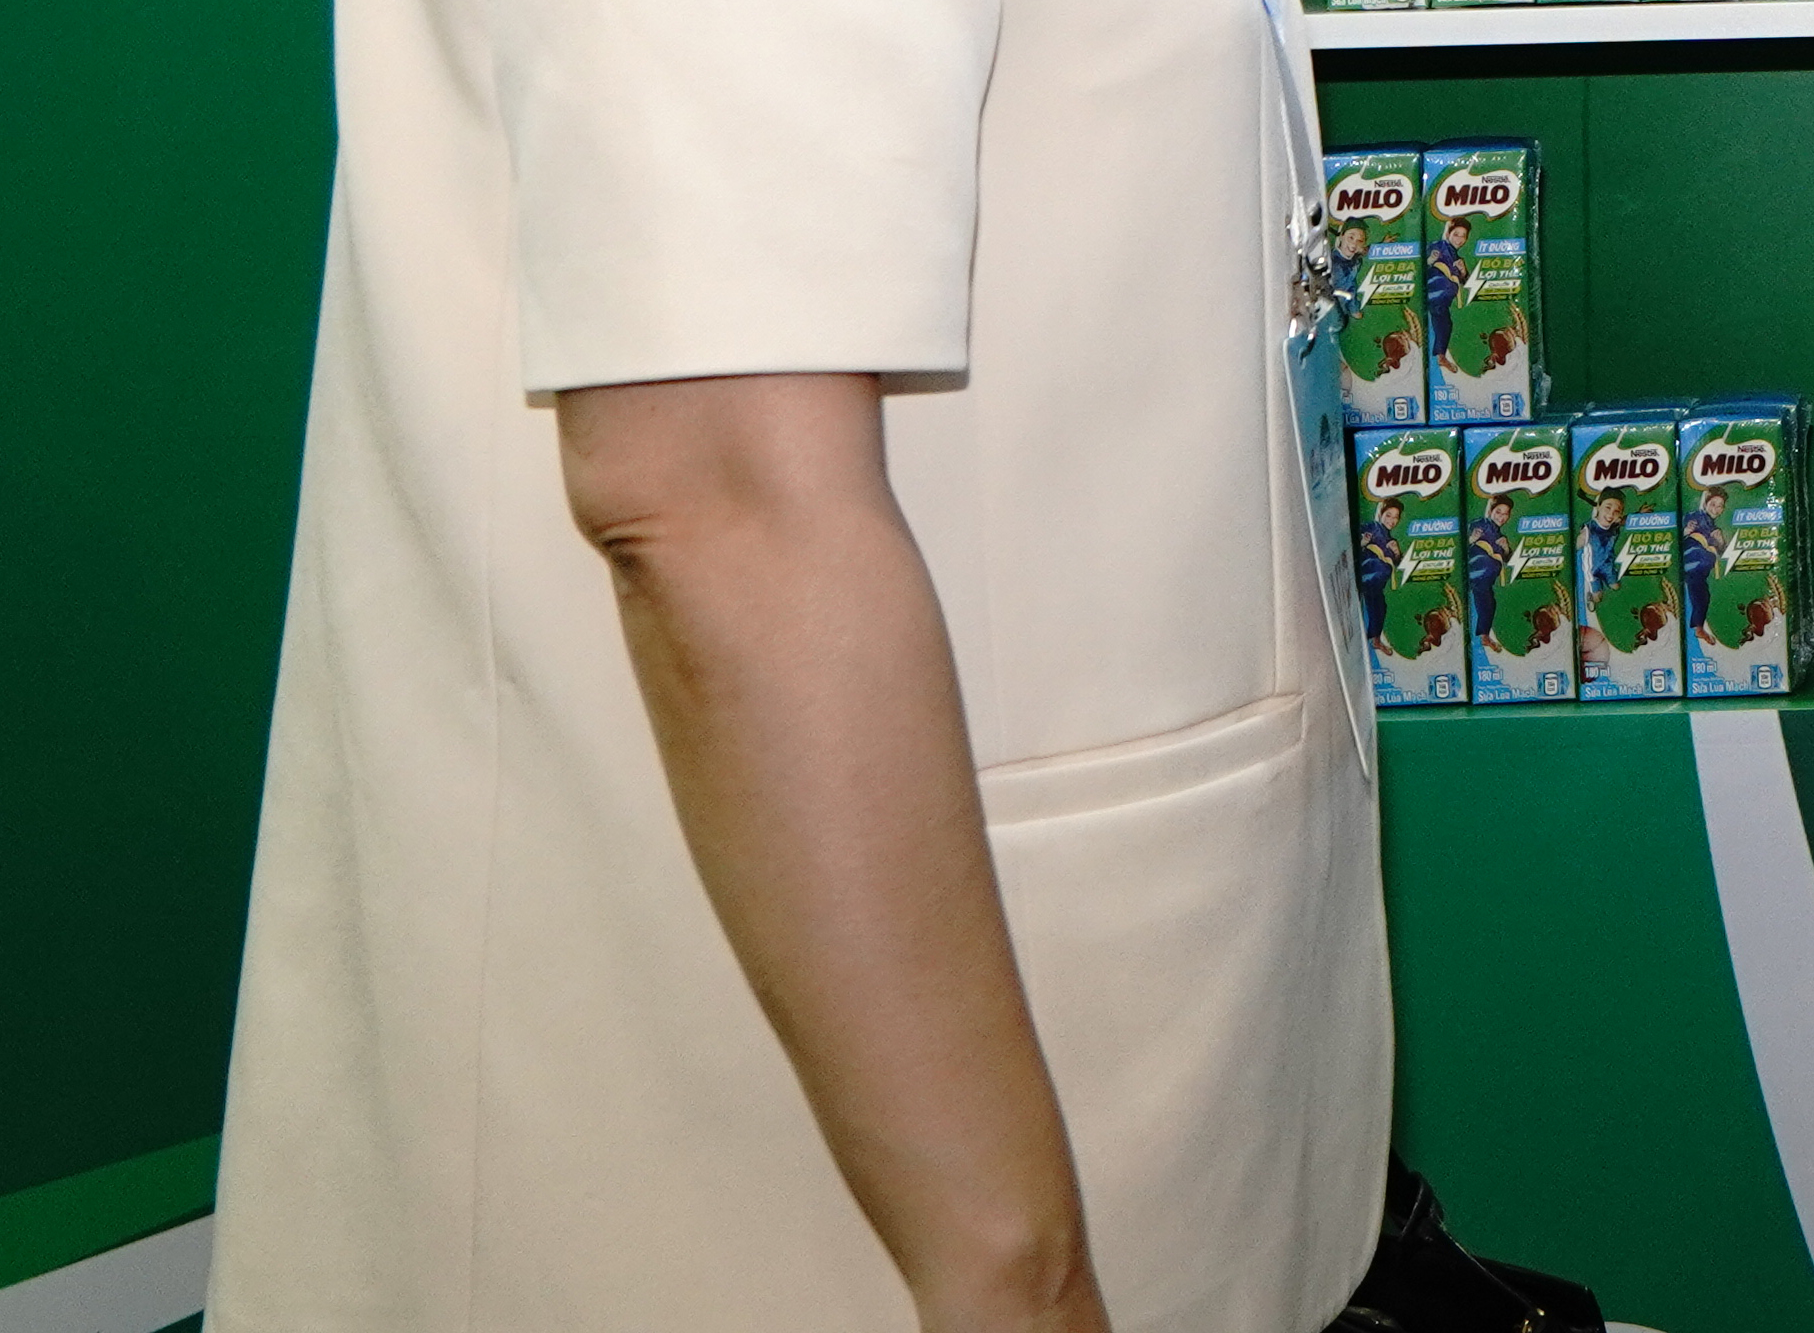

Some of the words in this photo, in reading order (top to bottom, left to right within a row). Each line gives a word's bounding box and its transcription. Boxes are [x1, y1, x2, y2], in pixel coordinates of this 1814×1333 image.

[1337, 189, 1403, 211] MILO
[1444, 184, 1510, 207] MILO
[1375, 462, 1443, 487] MILO
[1700, 453, 1765, 476] MILO
